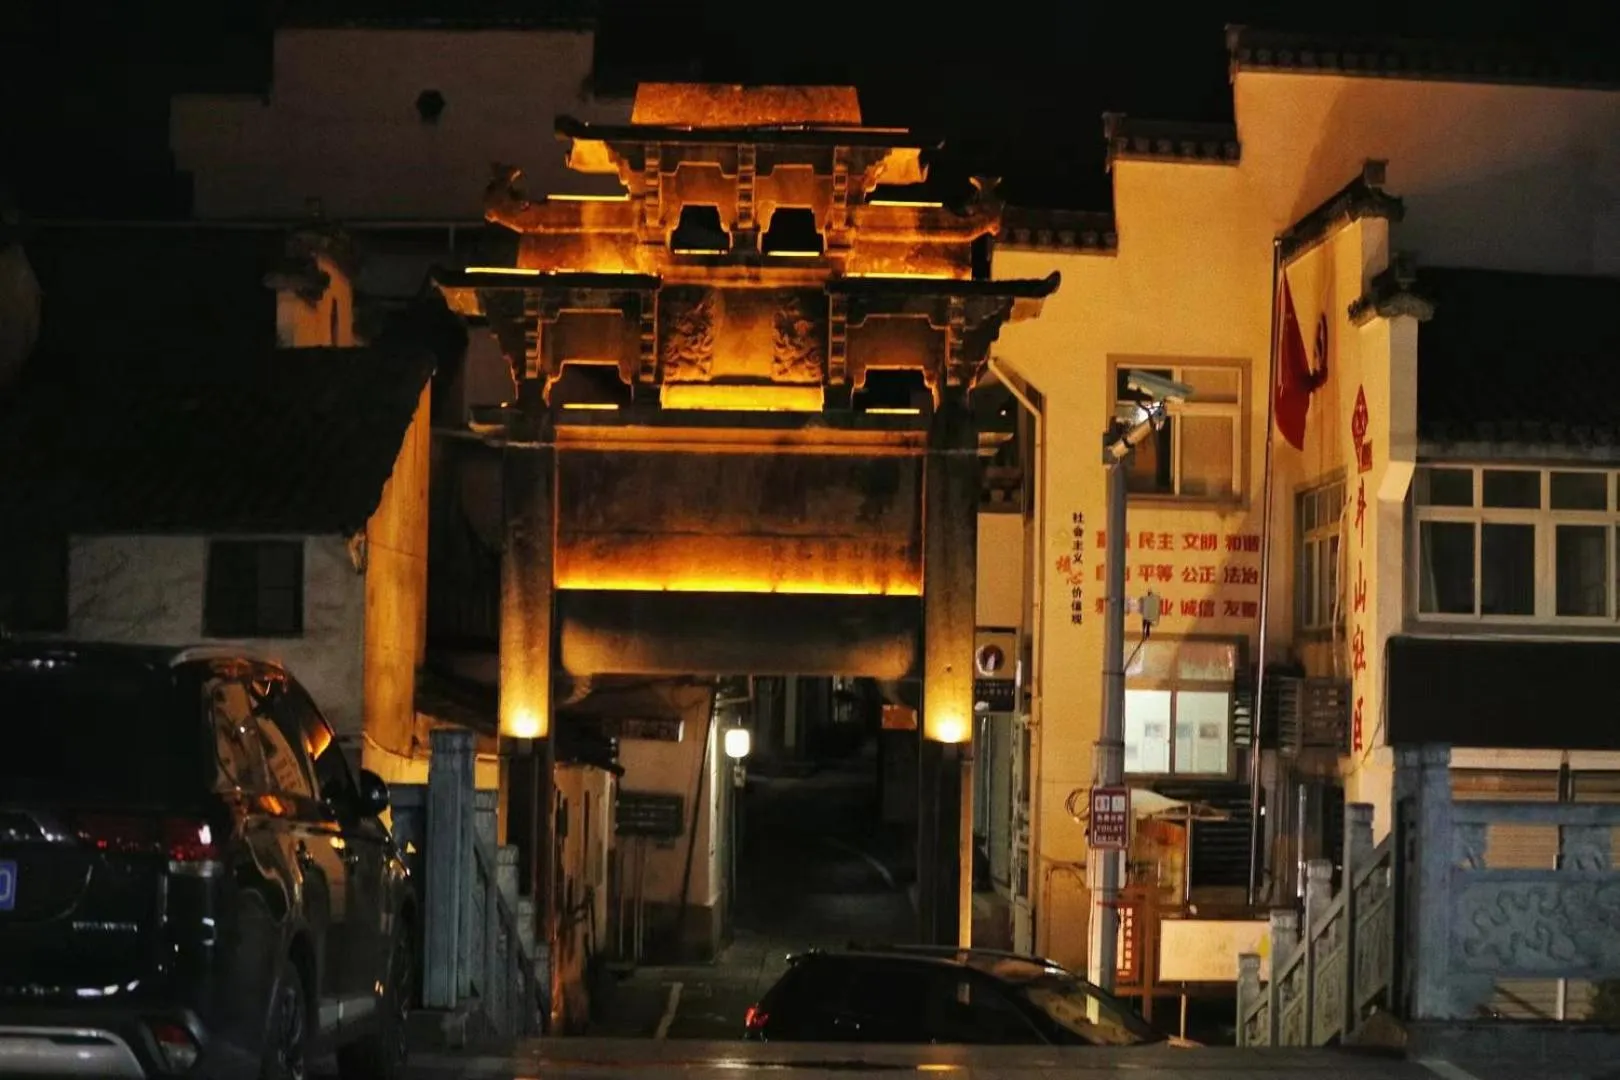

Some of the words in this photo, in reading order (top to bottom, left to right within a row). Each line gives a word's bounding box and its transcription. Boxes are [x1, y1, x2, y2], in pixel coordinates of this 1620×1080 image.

[1138, 531, 1174, 551] 民主
[1181, 532, 1218, 551] 文明
[1225, 533, 1261, 553] 和谐
[1138, 564, 1174, 583] 平等
[1181, 565, 1216, 584] 公正
[1223, 565, 1259, 585] 法治
[1180, 598, 1216, 618] 诚信
[1223, 599, 1258, 618] 友善
